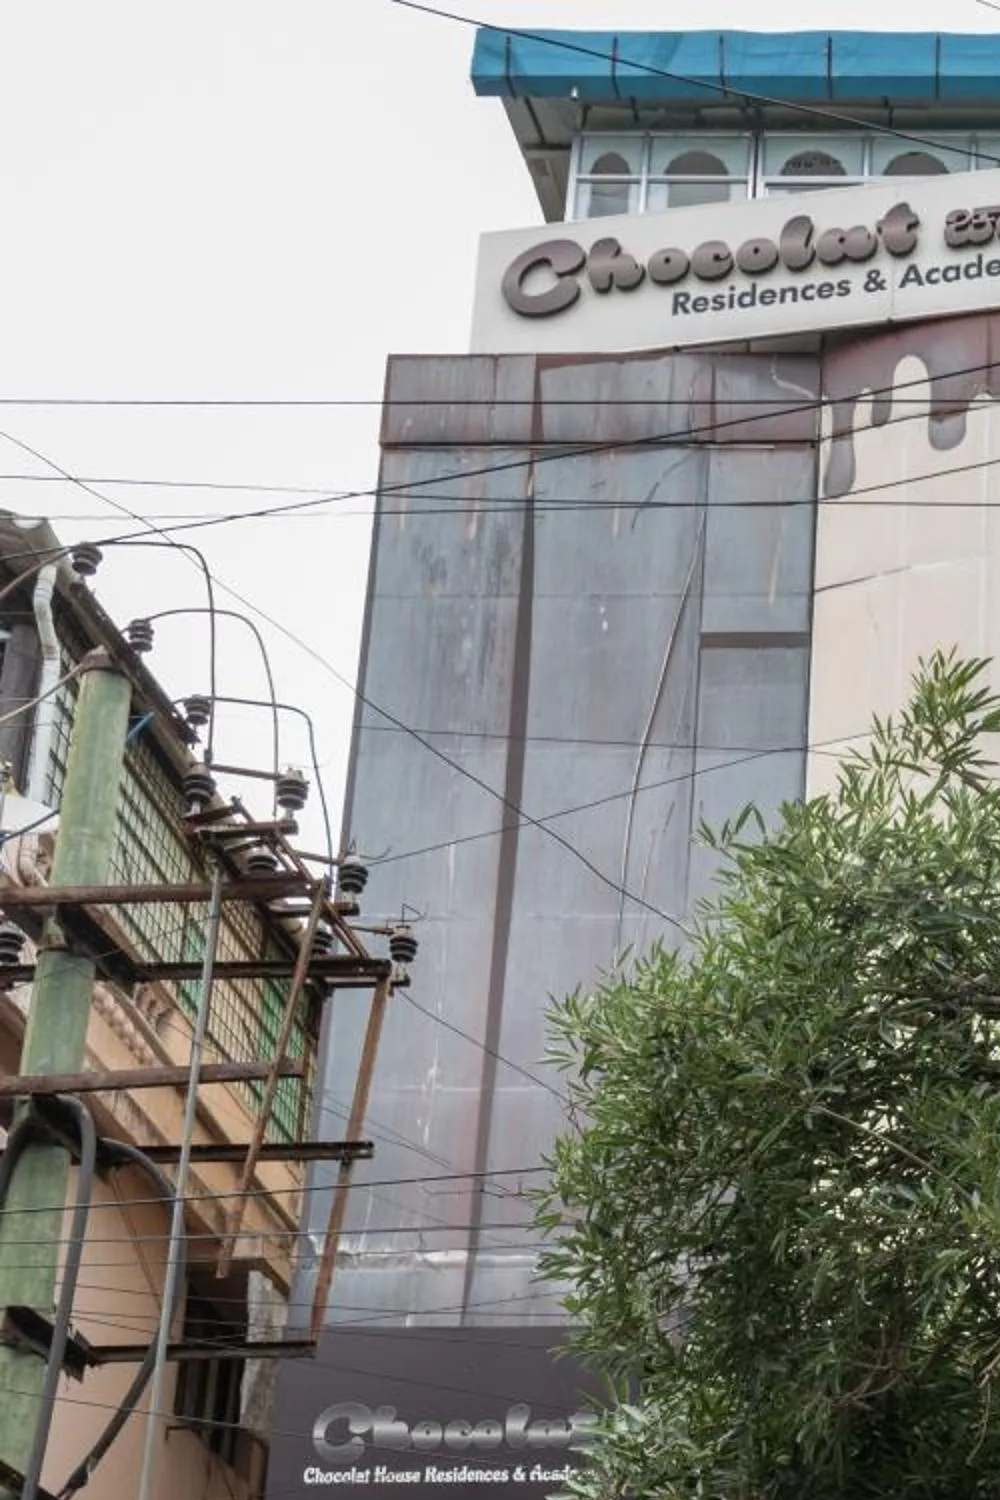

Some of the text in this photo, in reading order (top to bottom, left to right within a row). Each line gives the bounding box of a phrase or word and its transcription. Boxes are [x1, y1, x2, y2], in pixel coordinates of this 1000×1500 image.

[502, 201, 920, 318] Chocolat
[671, 276, 852, 316] Residences
[863, 269, 887, 293] &
[303, 1465, 370, 1484] Chocolat
[374, 1465, 421, 1483] House
[425, 1465, 509, 1483] Residences
[512, 1465, 527, 1483] &
